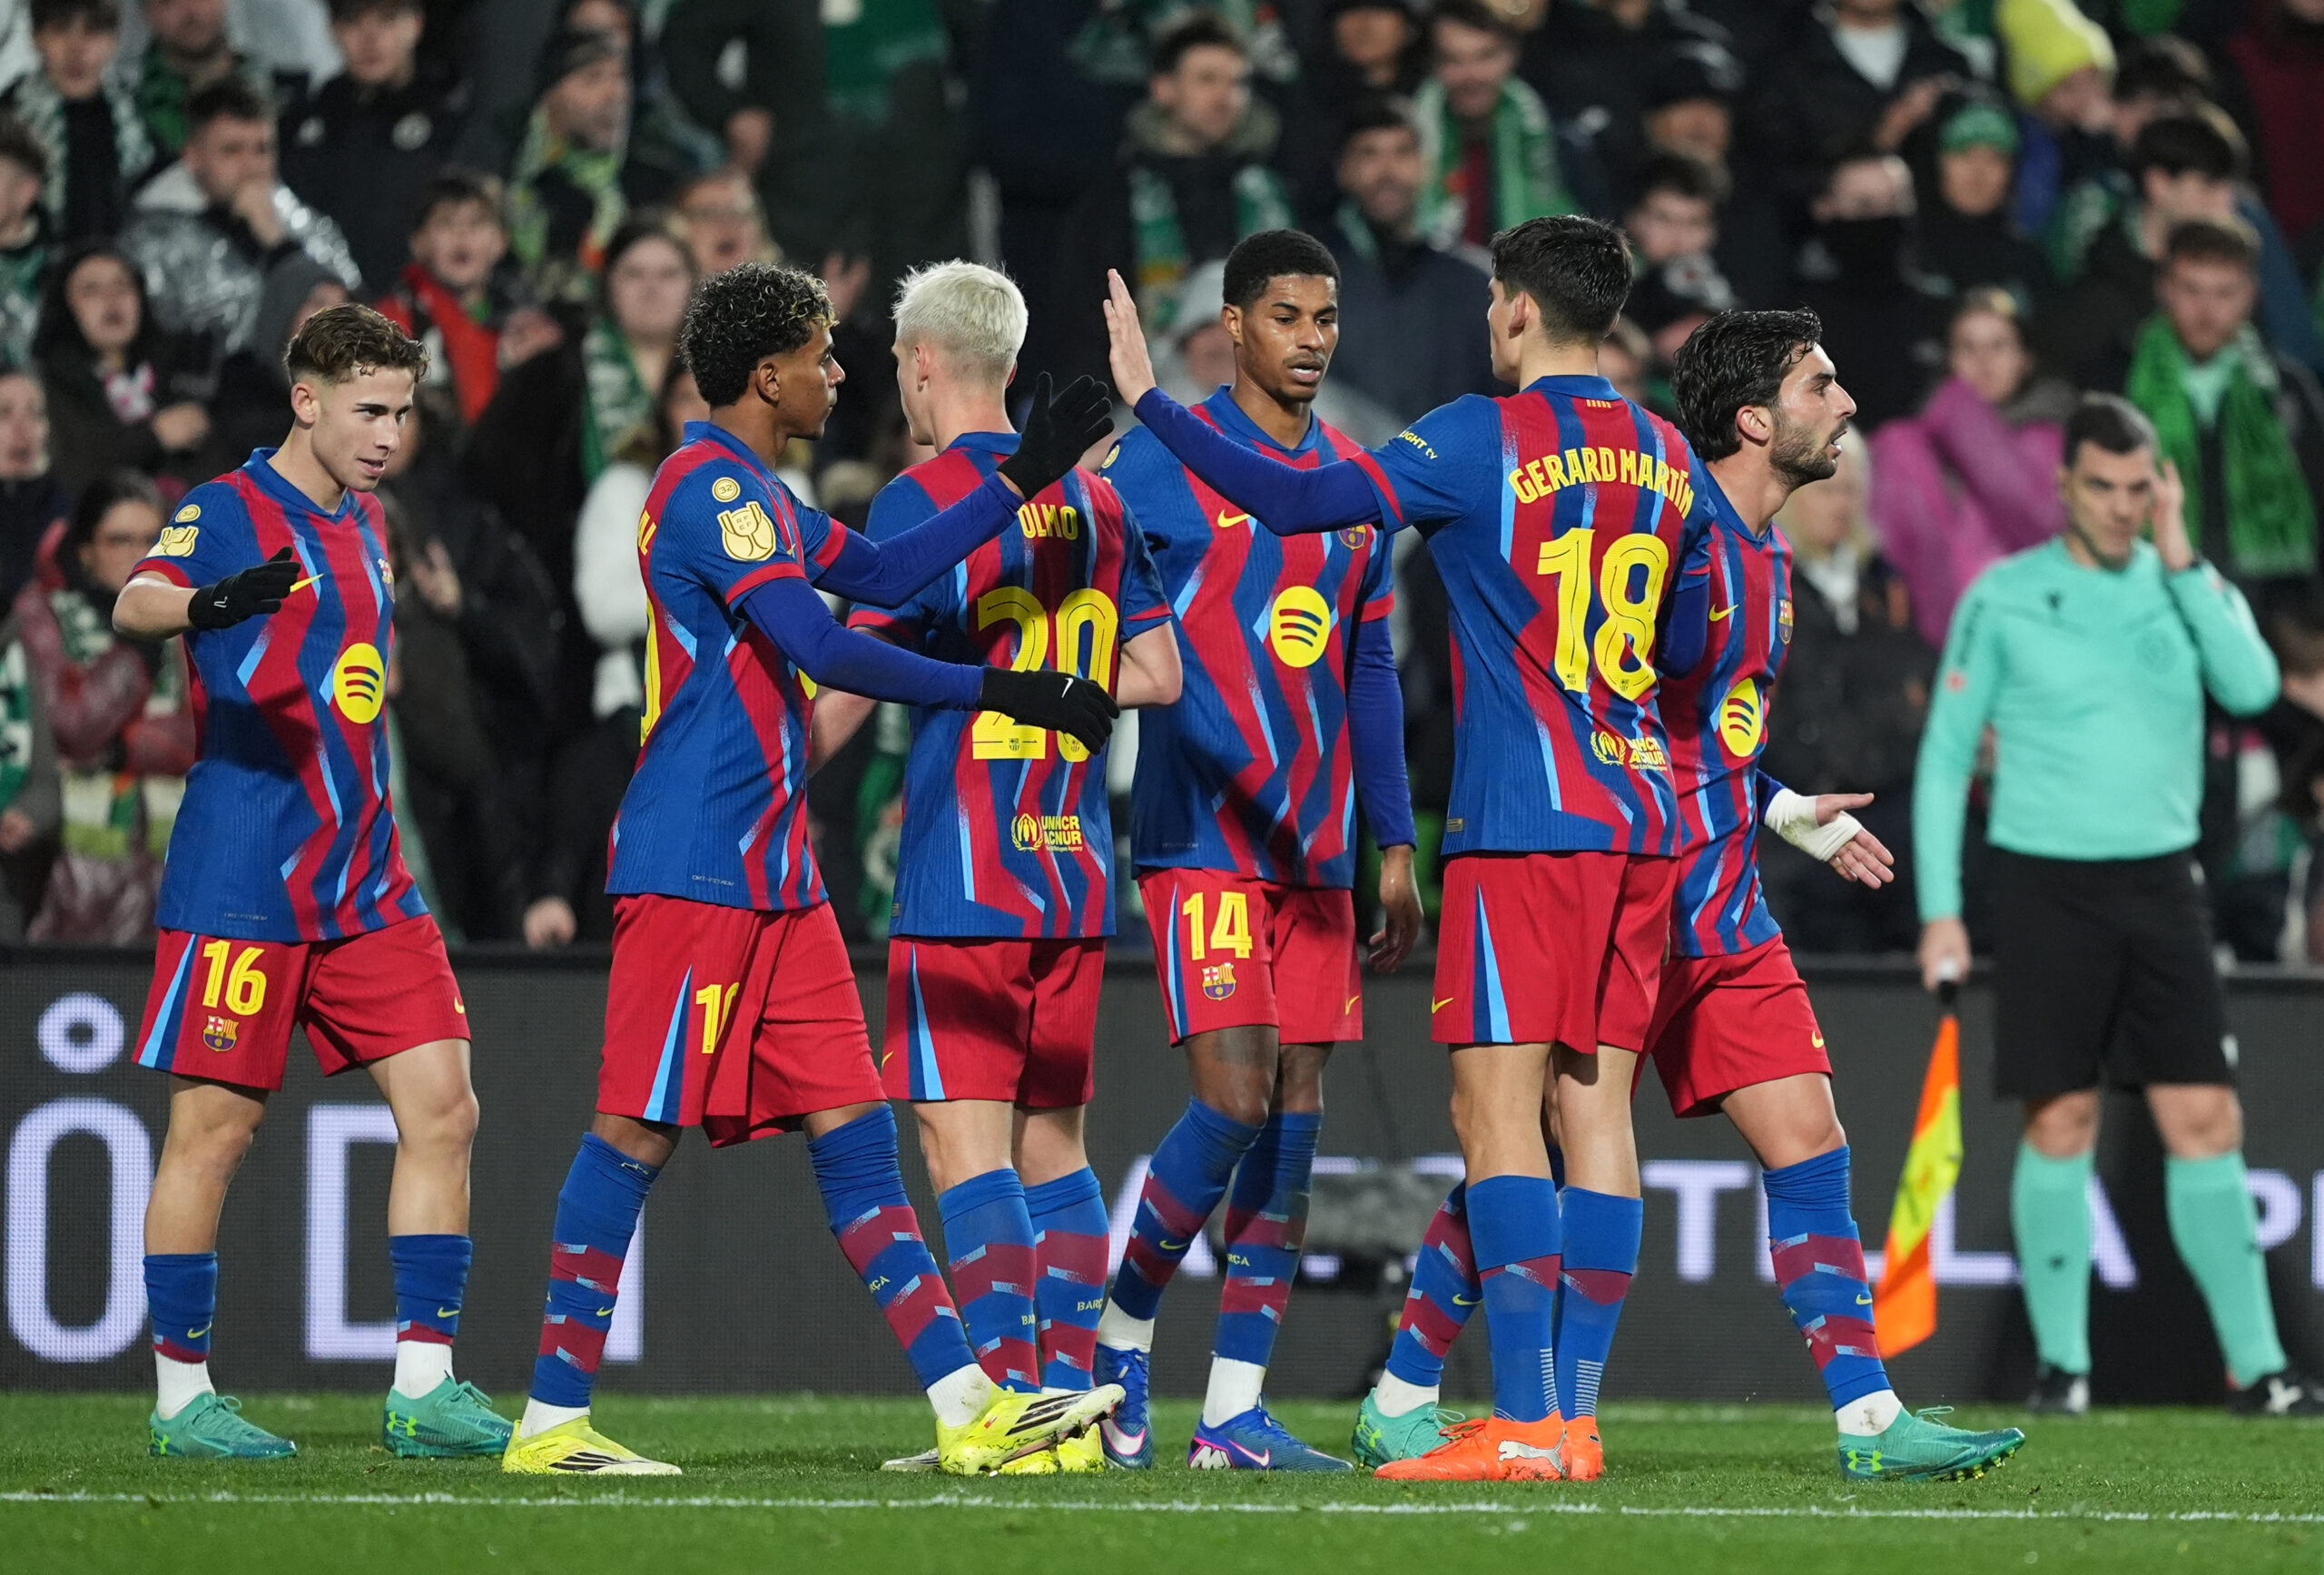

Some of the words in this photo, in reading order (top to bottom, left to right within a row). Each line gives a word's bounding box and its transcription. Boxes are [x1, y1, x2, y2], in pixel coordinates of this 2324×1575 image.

[719, 484, 733, 494] 32
[1508, 447, 1617, 504] GERARD
[1620, 448, 1695, 520] MARTÍN
[1017, 503, 1078, 540] OLMO
[1537, 527, 1669, 701] 18
[972, 586, 1118, 763] 20
[1041, 815, 1080, 831] UNHCR
[1043, 830, 1083, 845] ACNUR
[1182, 891, 1253, 960] 14
[202, 940, 267, 1016] 16
